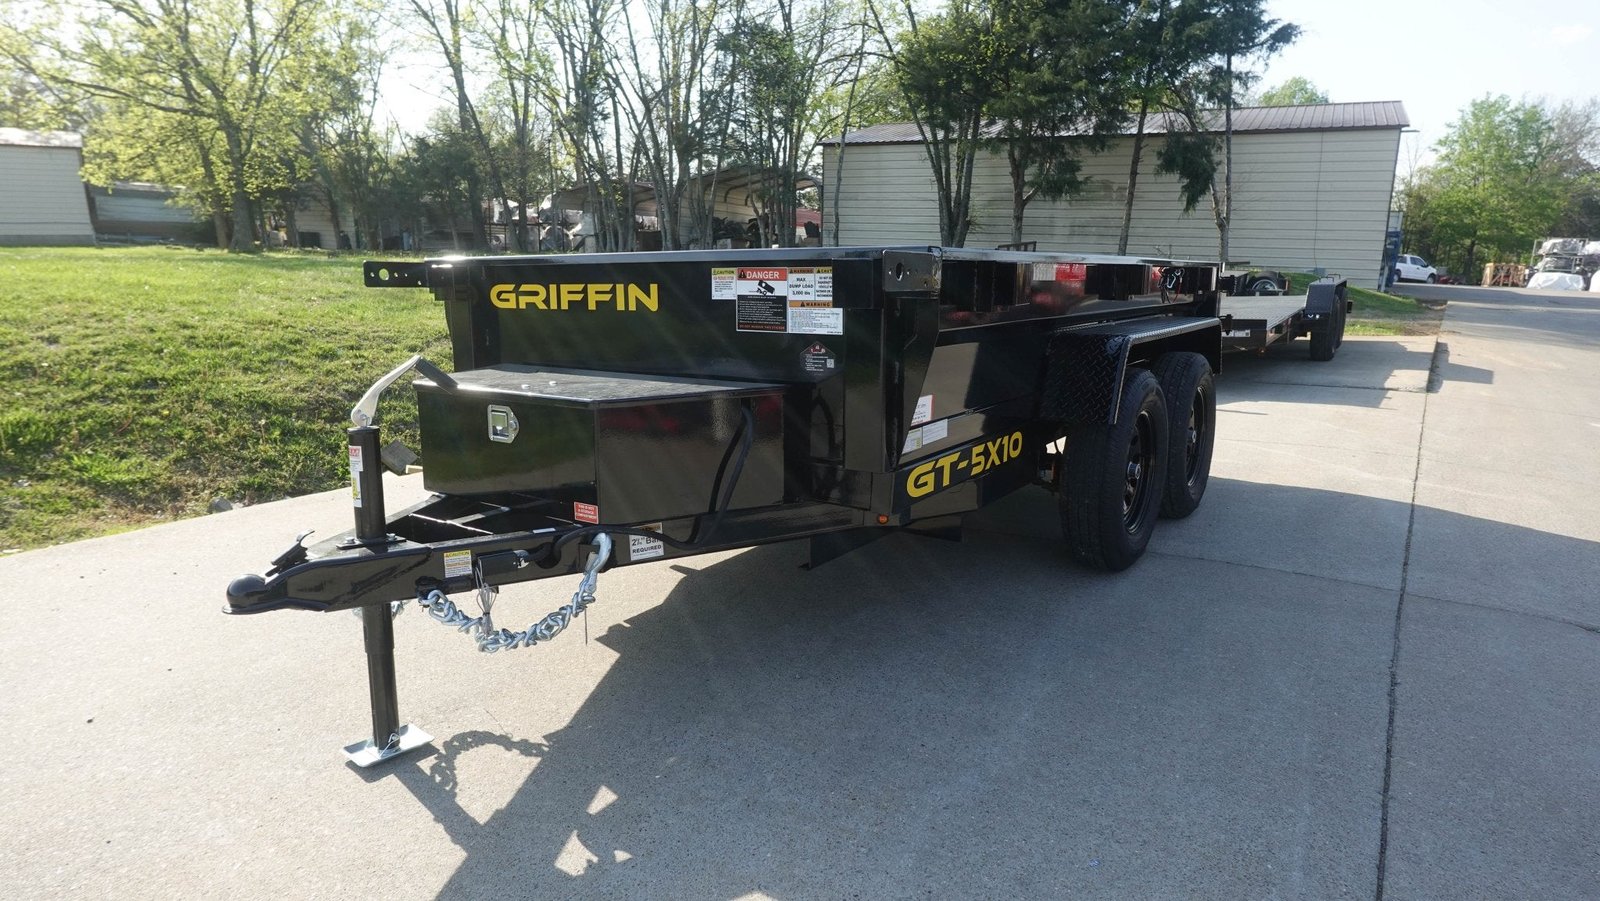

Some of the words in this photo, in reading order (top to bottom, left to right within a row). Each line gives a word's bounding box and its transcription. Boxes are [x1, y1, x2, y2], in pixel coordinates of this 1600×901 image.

[746, 271, 780, 279] DANGER
[489, 283, 659, 312] GRIFFIN
[906, 431, 1023, 498] GT-5X10
[632, 544, 662, 553] REQUIRED
